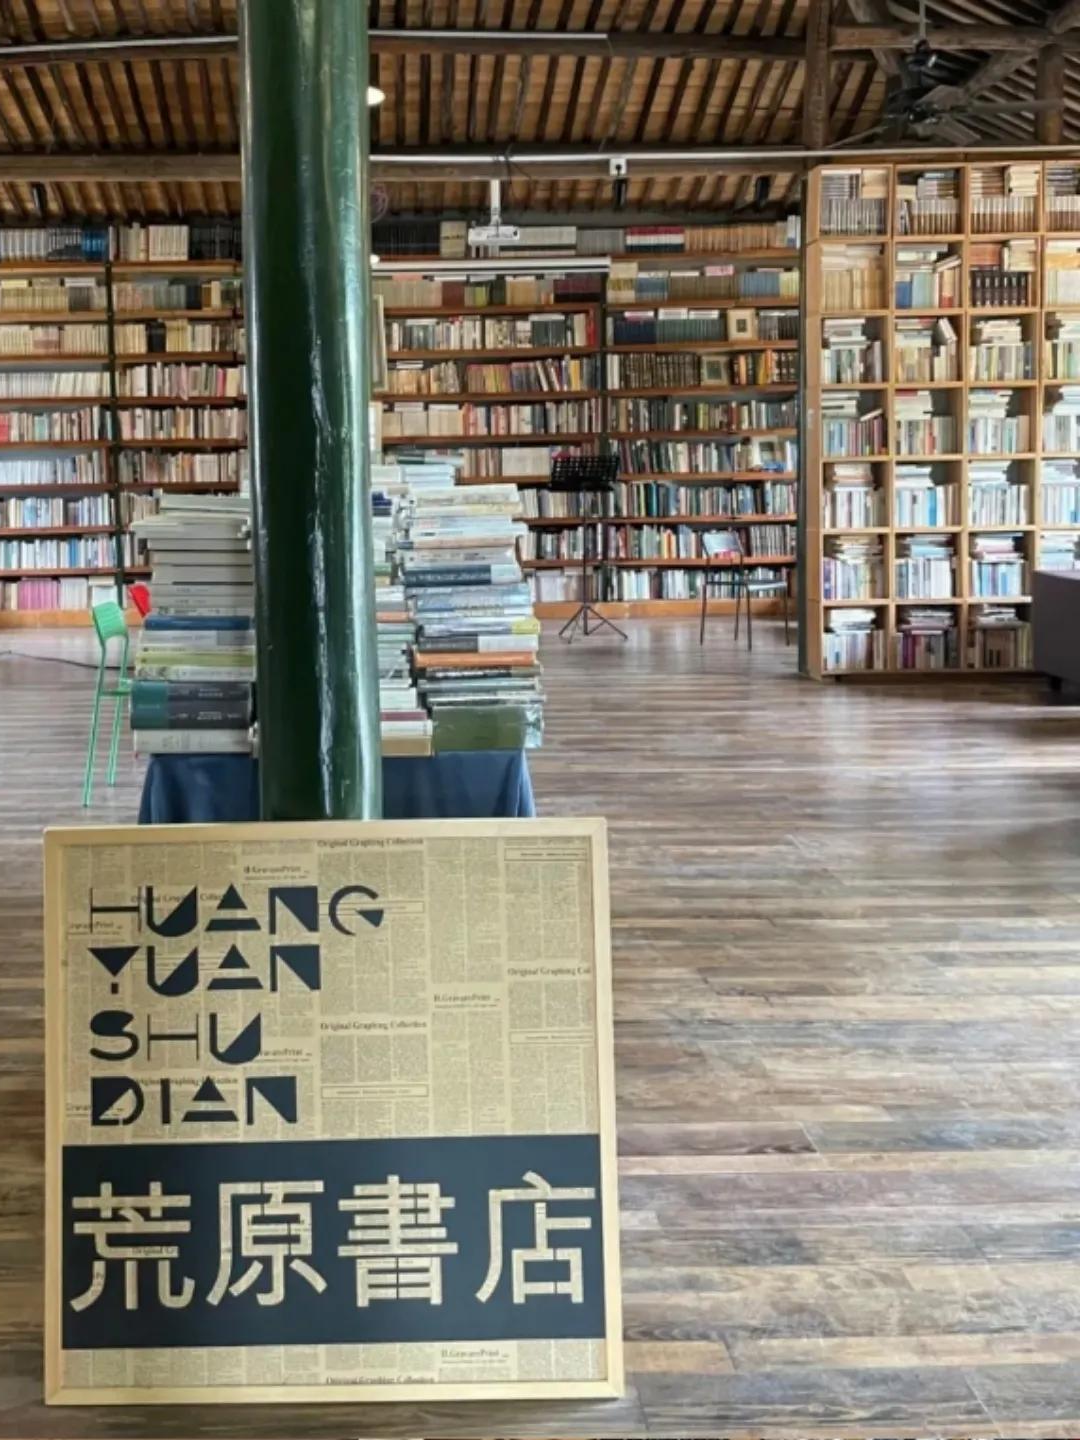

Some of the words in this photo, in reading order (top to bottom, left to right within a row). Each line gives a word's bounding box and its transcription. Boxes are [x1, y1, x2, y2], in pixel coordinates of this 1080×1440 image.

[89, 883, 383, 937] HUANG
[88, 945, 320, 997] YUAN
[90, 1010, 260, 1064] SHU
[91, 1076, 296, 1126] DIAN
[69, 1171, 595, 1310] 荒原書店
